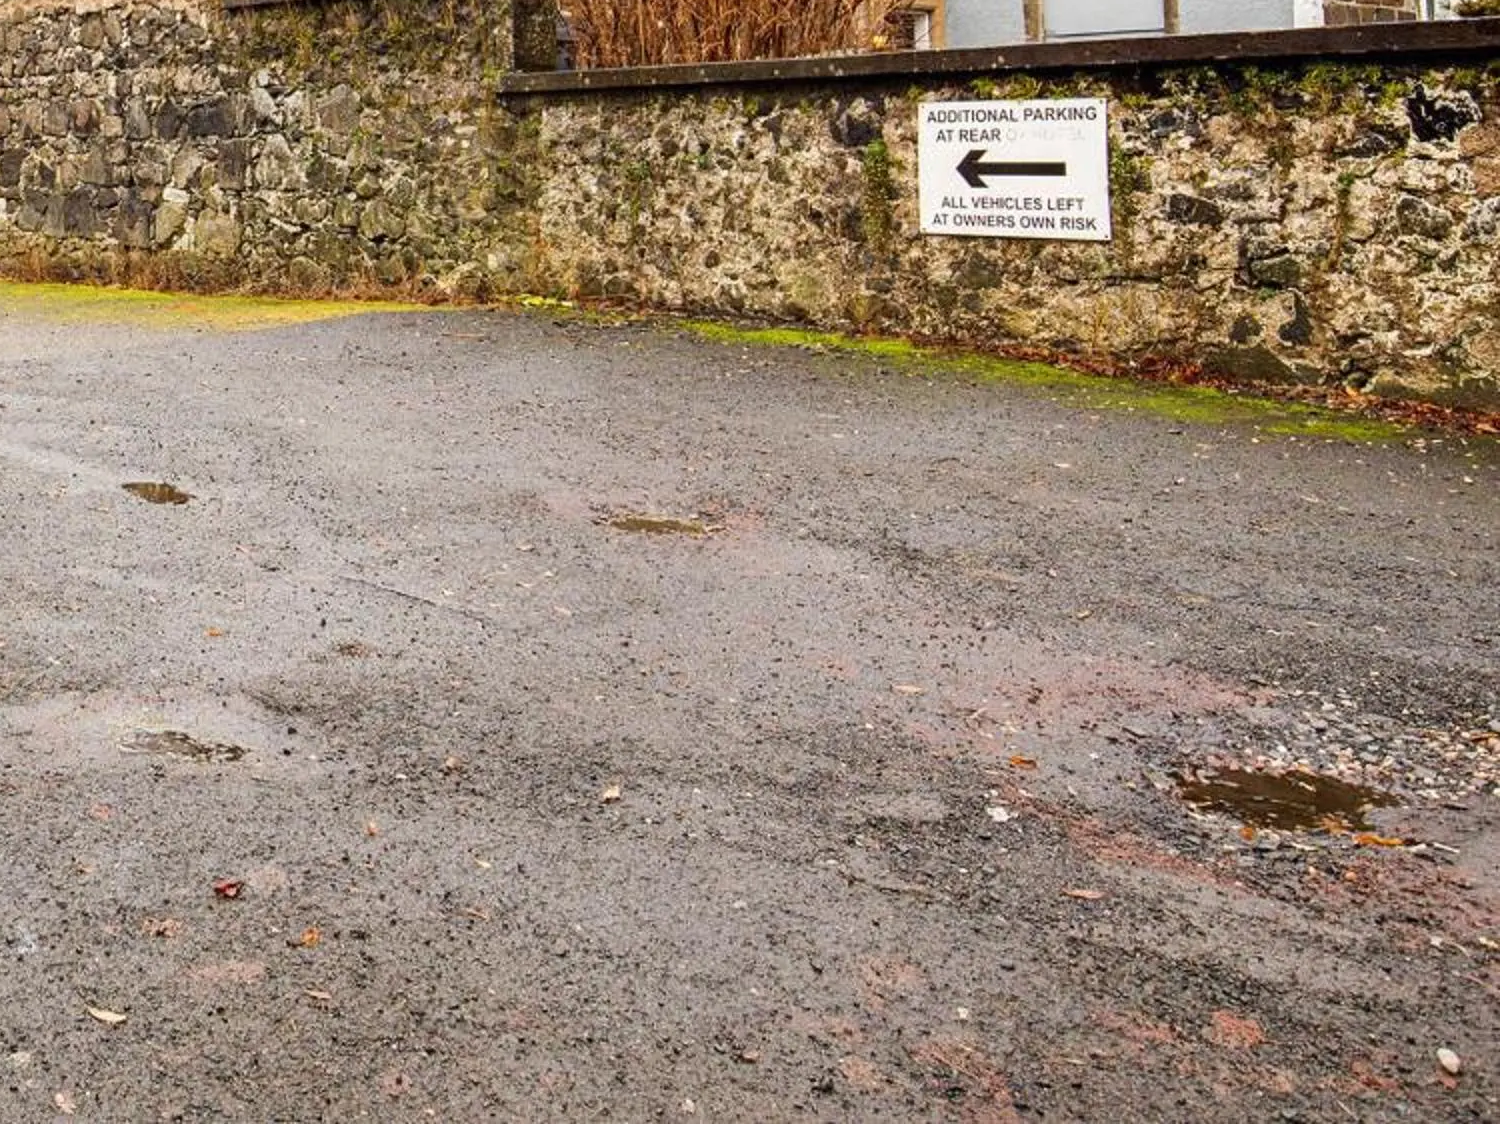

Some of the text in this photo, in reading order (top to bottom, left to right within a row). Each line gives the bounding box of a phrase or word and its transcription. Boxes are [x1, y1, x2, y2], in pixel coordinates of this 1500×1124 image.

[927, 106, 1097, 123] ADDITIONAL PARKING
[935, 129, 954, 143] AT
[959, 128, 1001, 142] REAR
[941, 197, 1084, 211] ALL VEHICLES LEFT
[932, 214, 1097, 230] AT OWNERS OWN RISK
